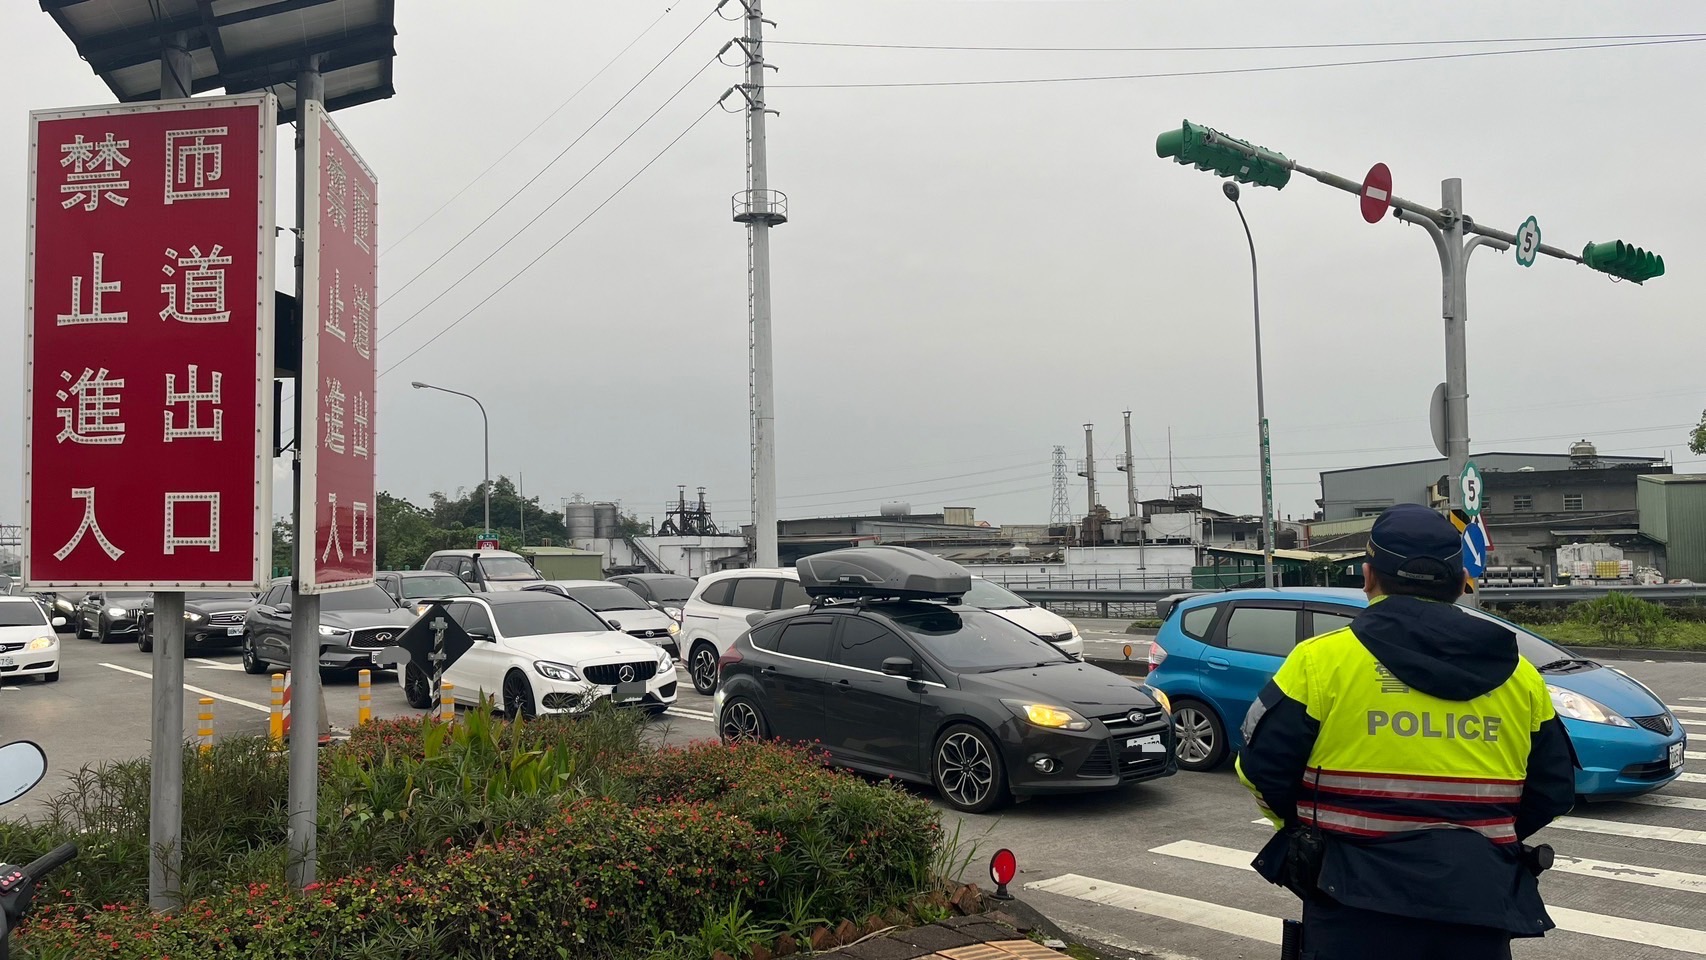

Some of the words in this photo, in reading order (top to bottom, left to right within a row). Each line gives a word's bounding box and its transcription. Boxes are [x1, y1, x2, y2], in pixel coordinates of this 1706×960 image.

[53, 133, 132, 562] 禁止進入
[159, 127, 232, 555] 匝道出口
[1523, 232, 1533, 252] 5
[322, 147, 346, 564] 禁止進入
[1468, 480, 1476, 502] 5
[1368, 710, 1502, 741] POLICE
